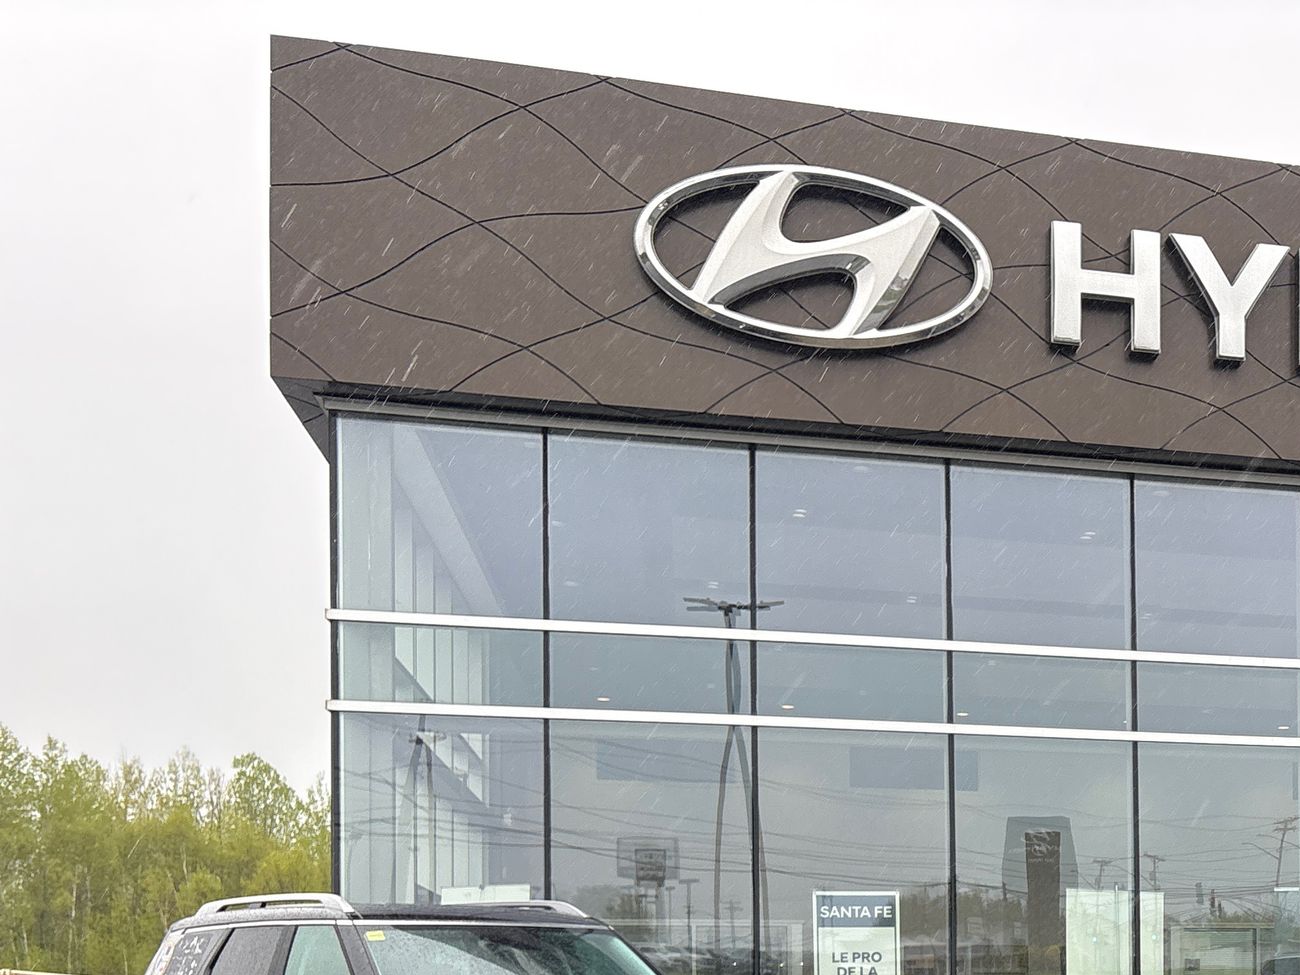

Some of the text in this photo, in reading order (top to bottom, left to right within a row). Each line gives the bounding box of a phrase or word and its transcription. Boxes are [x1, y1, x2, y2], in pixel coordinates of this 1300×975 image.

[820, 906, 893, 918] SANTA FE
[832, 952, 882, 963] LE PRO
